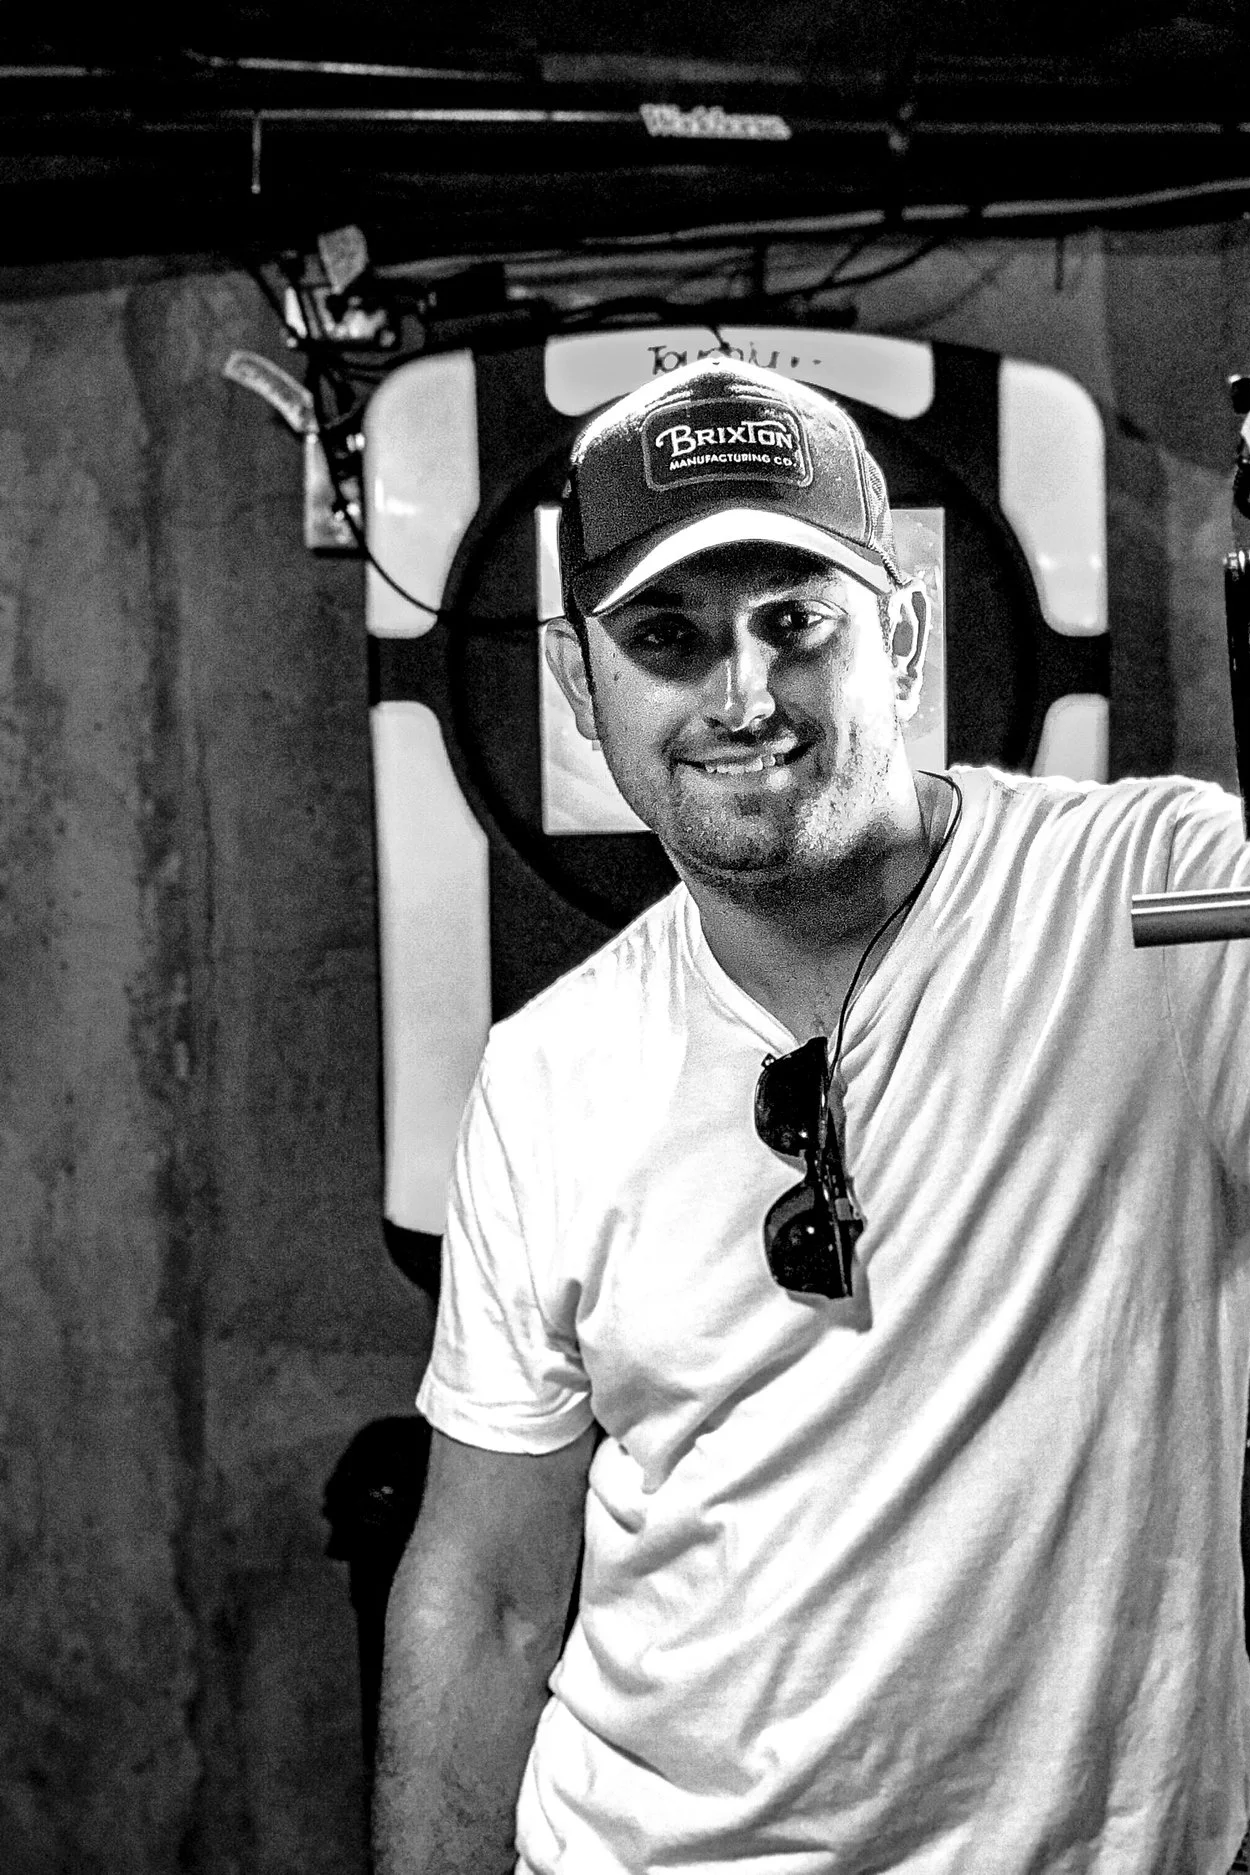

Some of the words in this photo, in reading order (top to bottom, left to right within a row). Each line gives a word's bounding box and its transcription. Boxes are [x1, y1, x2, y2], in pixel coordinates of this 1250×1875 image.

[655, 420, 793, 457] BRIXTON
[669, 453, 771, 470] MANUFACTURING
[773, 456, 797, 467] CO.
